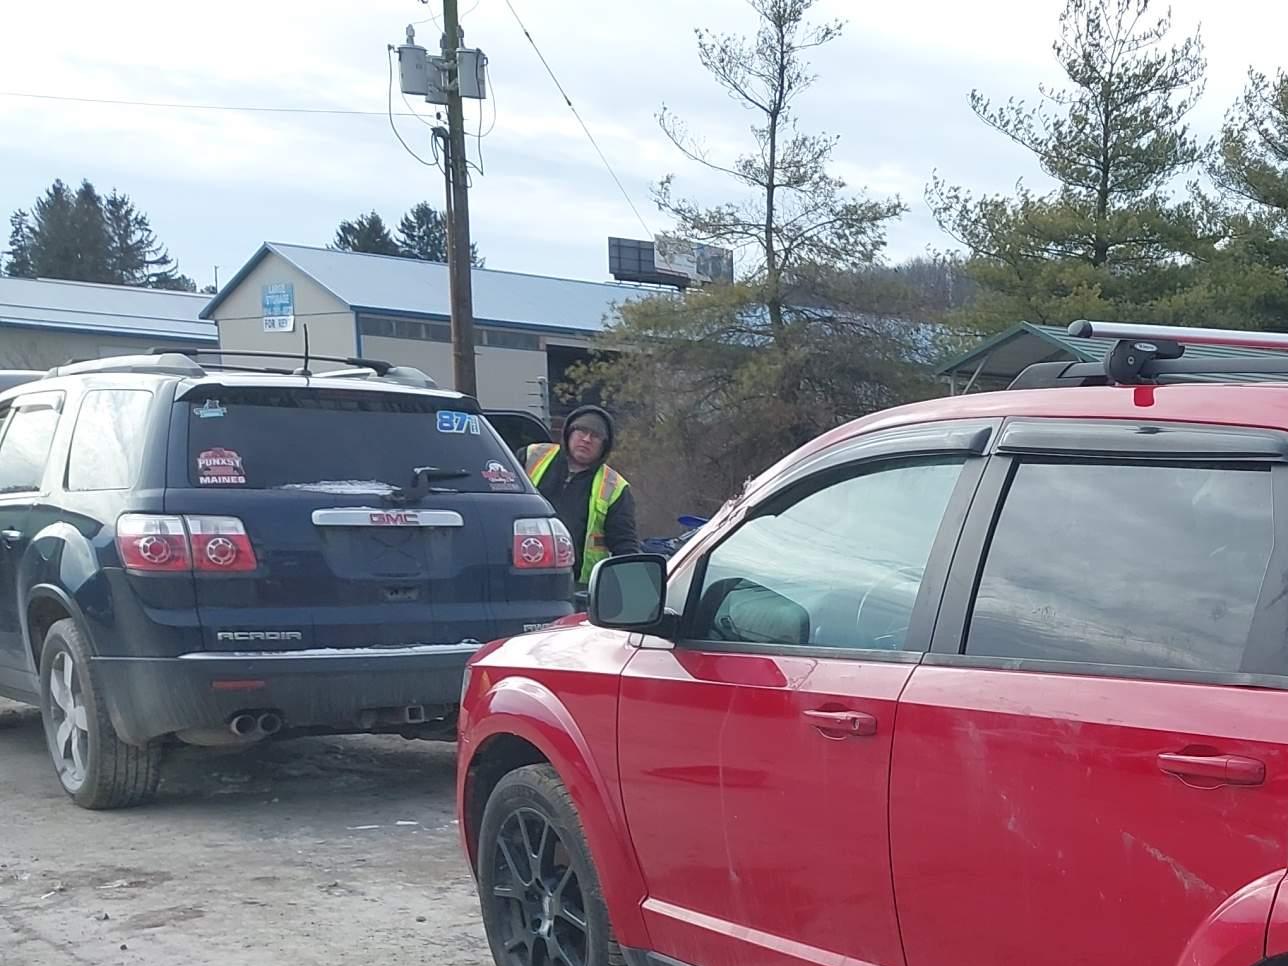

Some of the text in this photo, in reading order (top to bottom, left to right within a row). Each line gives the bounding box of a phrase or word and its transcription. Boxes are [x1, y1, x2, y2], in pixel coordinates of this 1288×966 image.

[197, 457, 242, 469] PUNXSY
[369, 512, 420, 525] GMC
[217, 631, 302, 641] ACADIA
